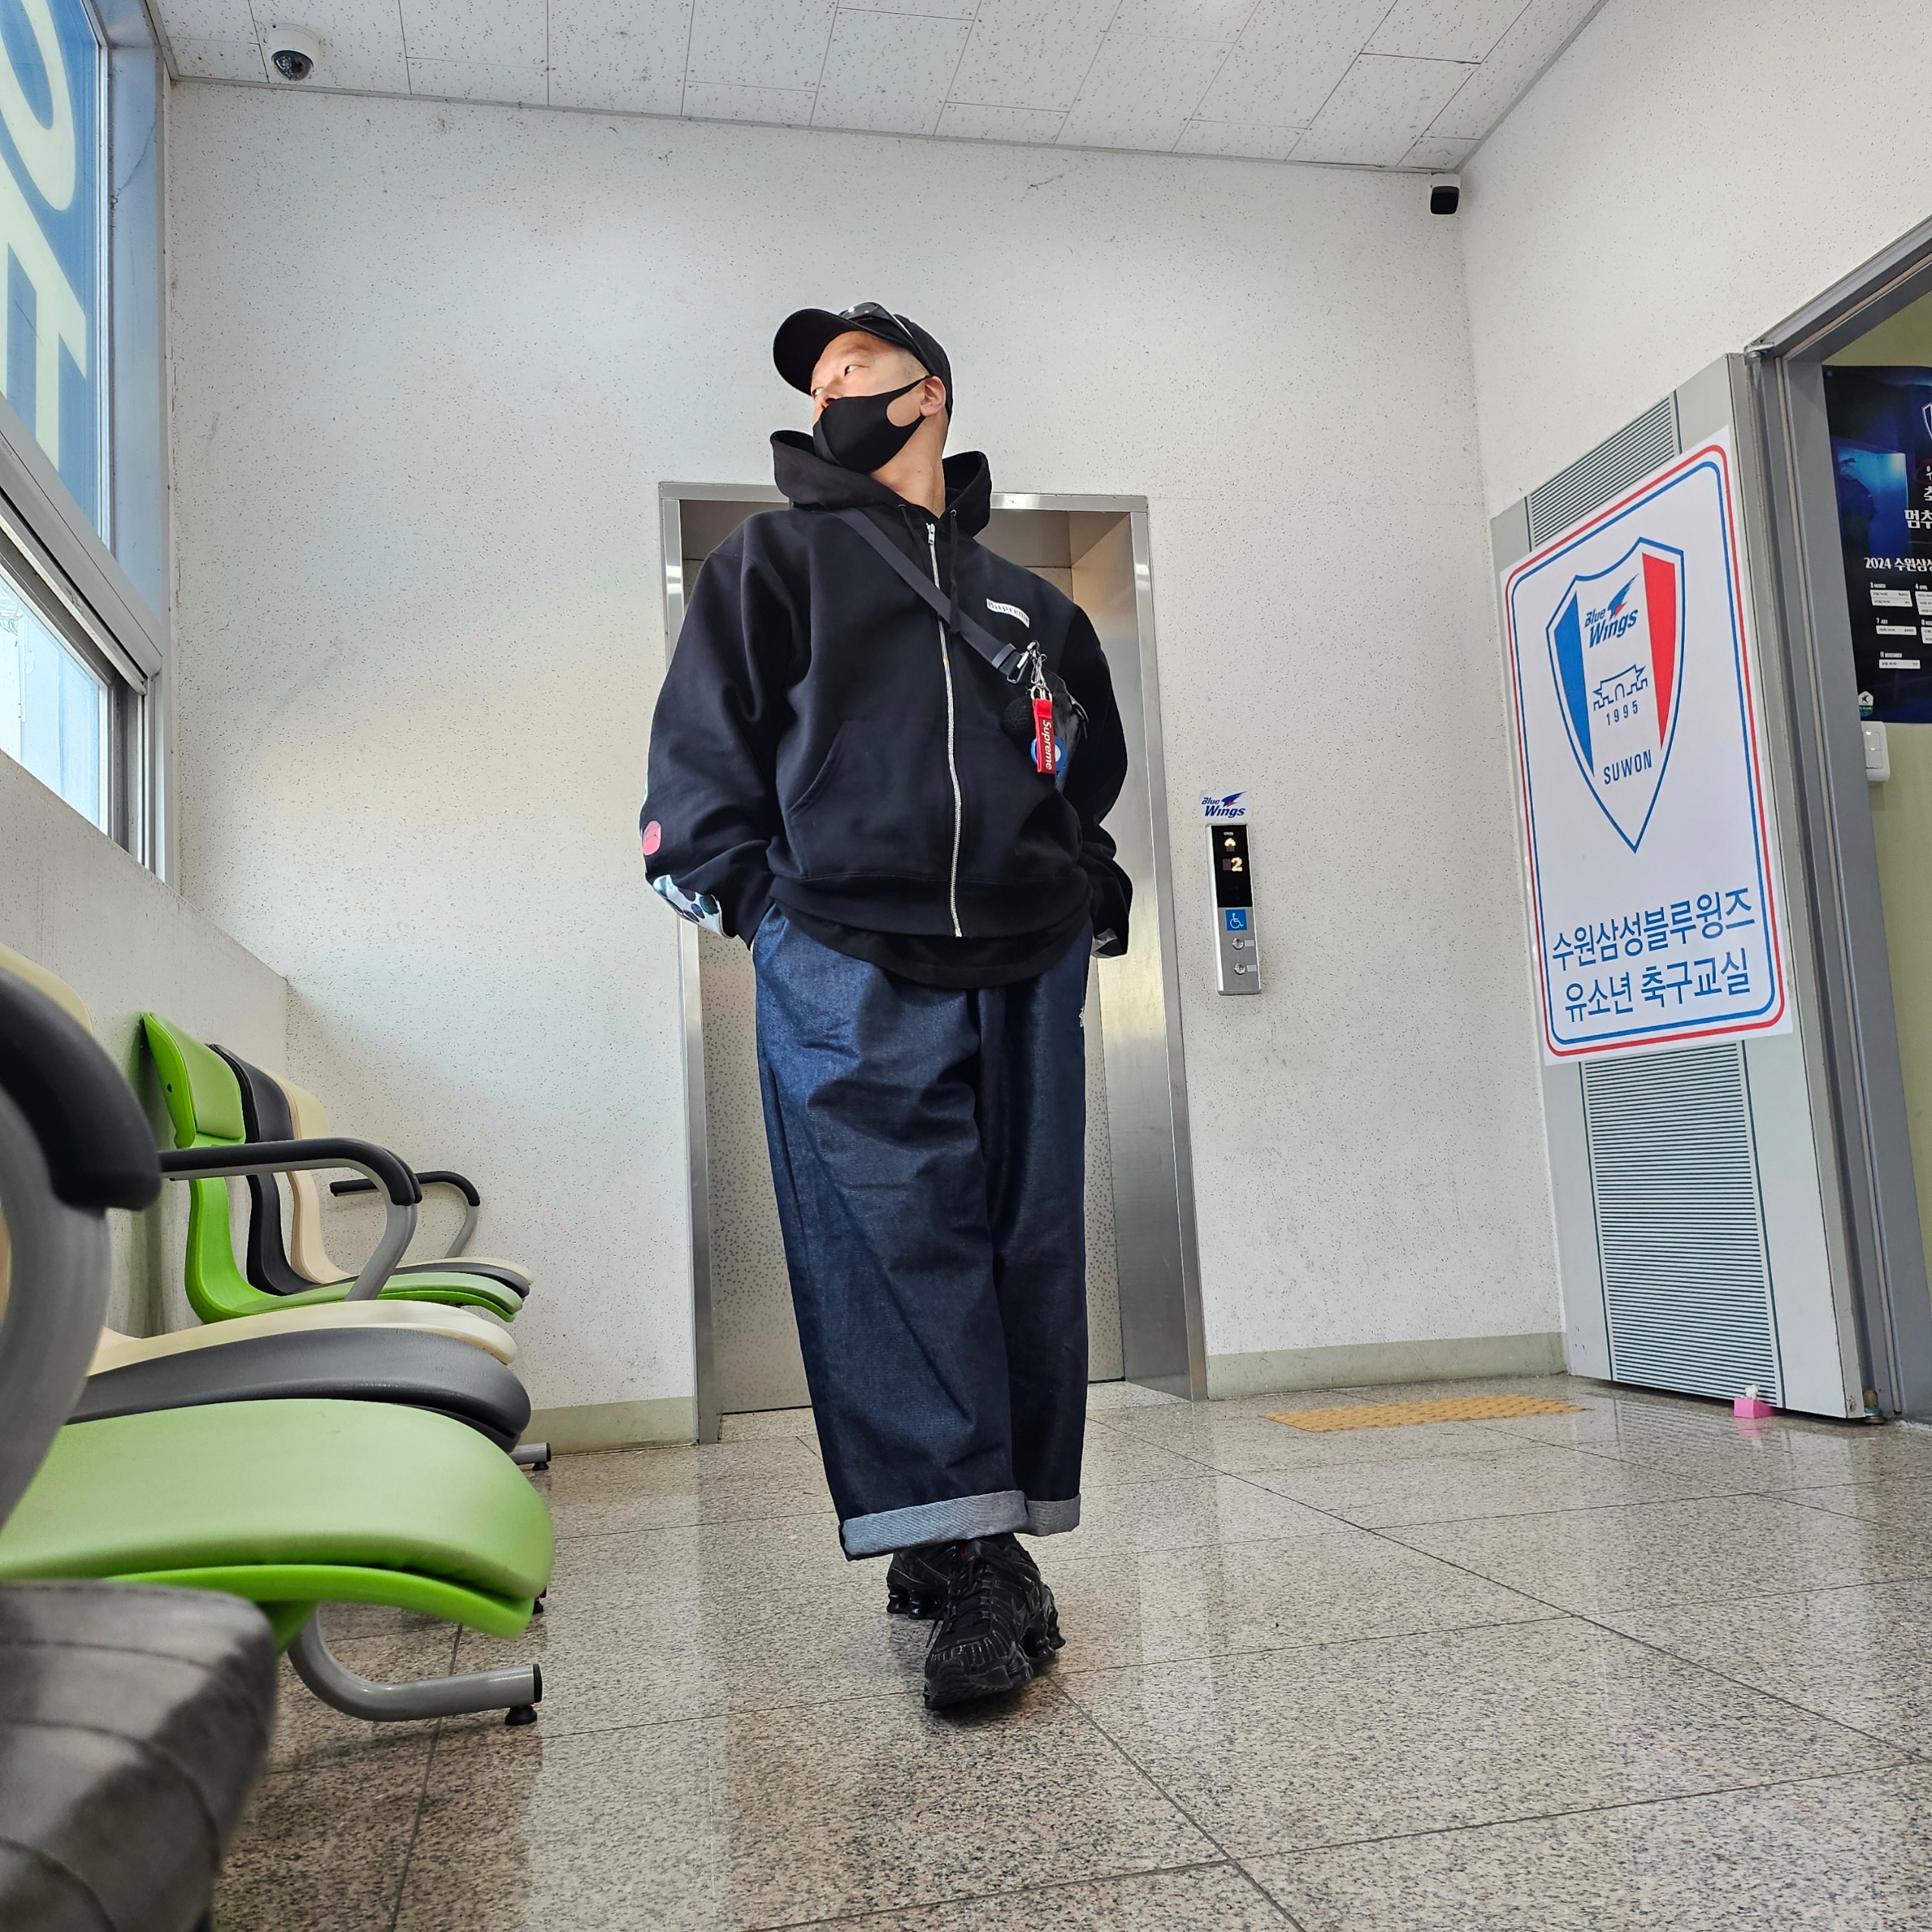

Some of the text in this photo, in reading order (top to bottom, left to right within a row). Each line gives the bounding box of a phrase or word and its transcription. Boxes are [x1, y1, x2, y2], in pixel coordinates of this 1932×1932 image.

[1864, 557, 1892, 569] 2024
[1584, 608, 1606, 628] Blue
[1589, 609, 1638, 648] Wings
[1606, 700, 1638, 725] 1995
[1040, 719, 1053, 770] Supreme
[1603, 748, 1652, 785] SUWON
[1201, 797, 1220, 805] Blue
[1204, 805, 1246, 818] Wings
[1231, 857, 1243, 872] 2
[1552, 887, 1755, 971] 수원삼성블루윙즈
[1565, 947, 1751, 1023] 유소년 축구교실
